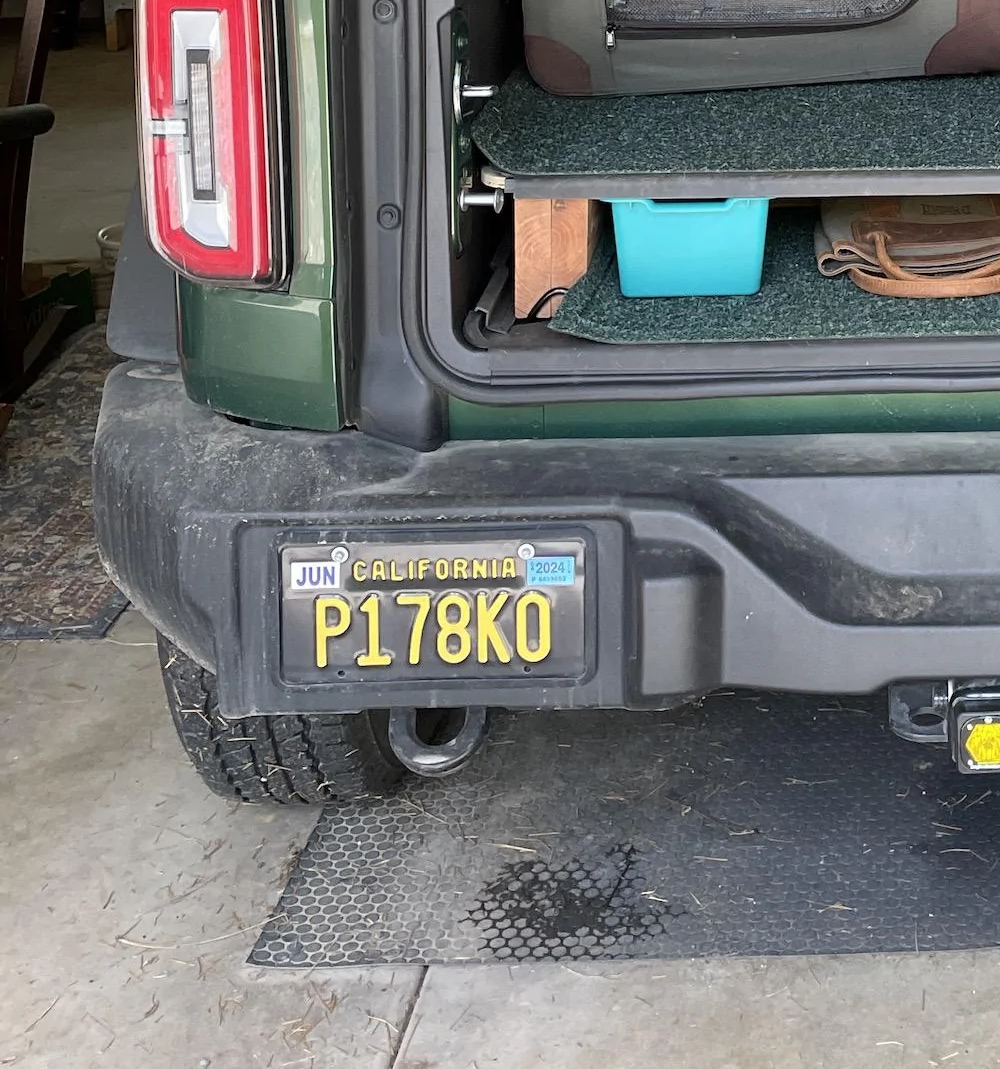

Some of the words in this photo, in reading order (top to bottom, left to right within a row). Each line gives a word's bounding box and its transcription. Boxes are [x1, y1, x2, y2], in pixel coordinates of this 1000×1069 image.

[296, 566, 336, 587] JUN
[352, 556, 517, 582] CALIFORNIA
[535, 562, 565, 574] 2024
